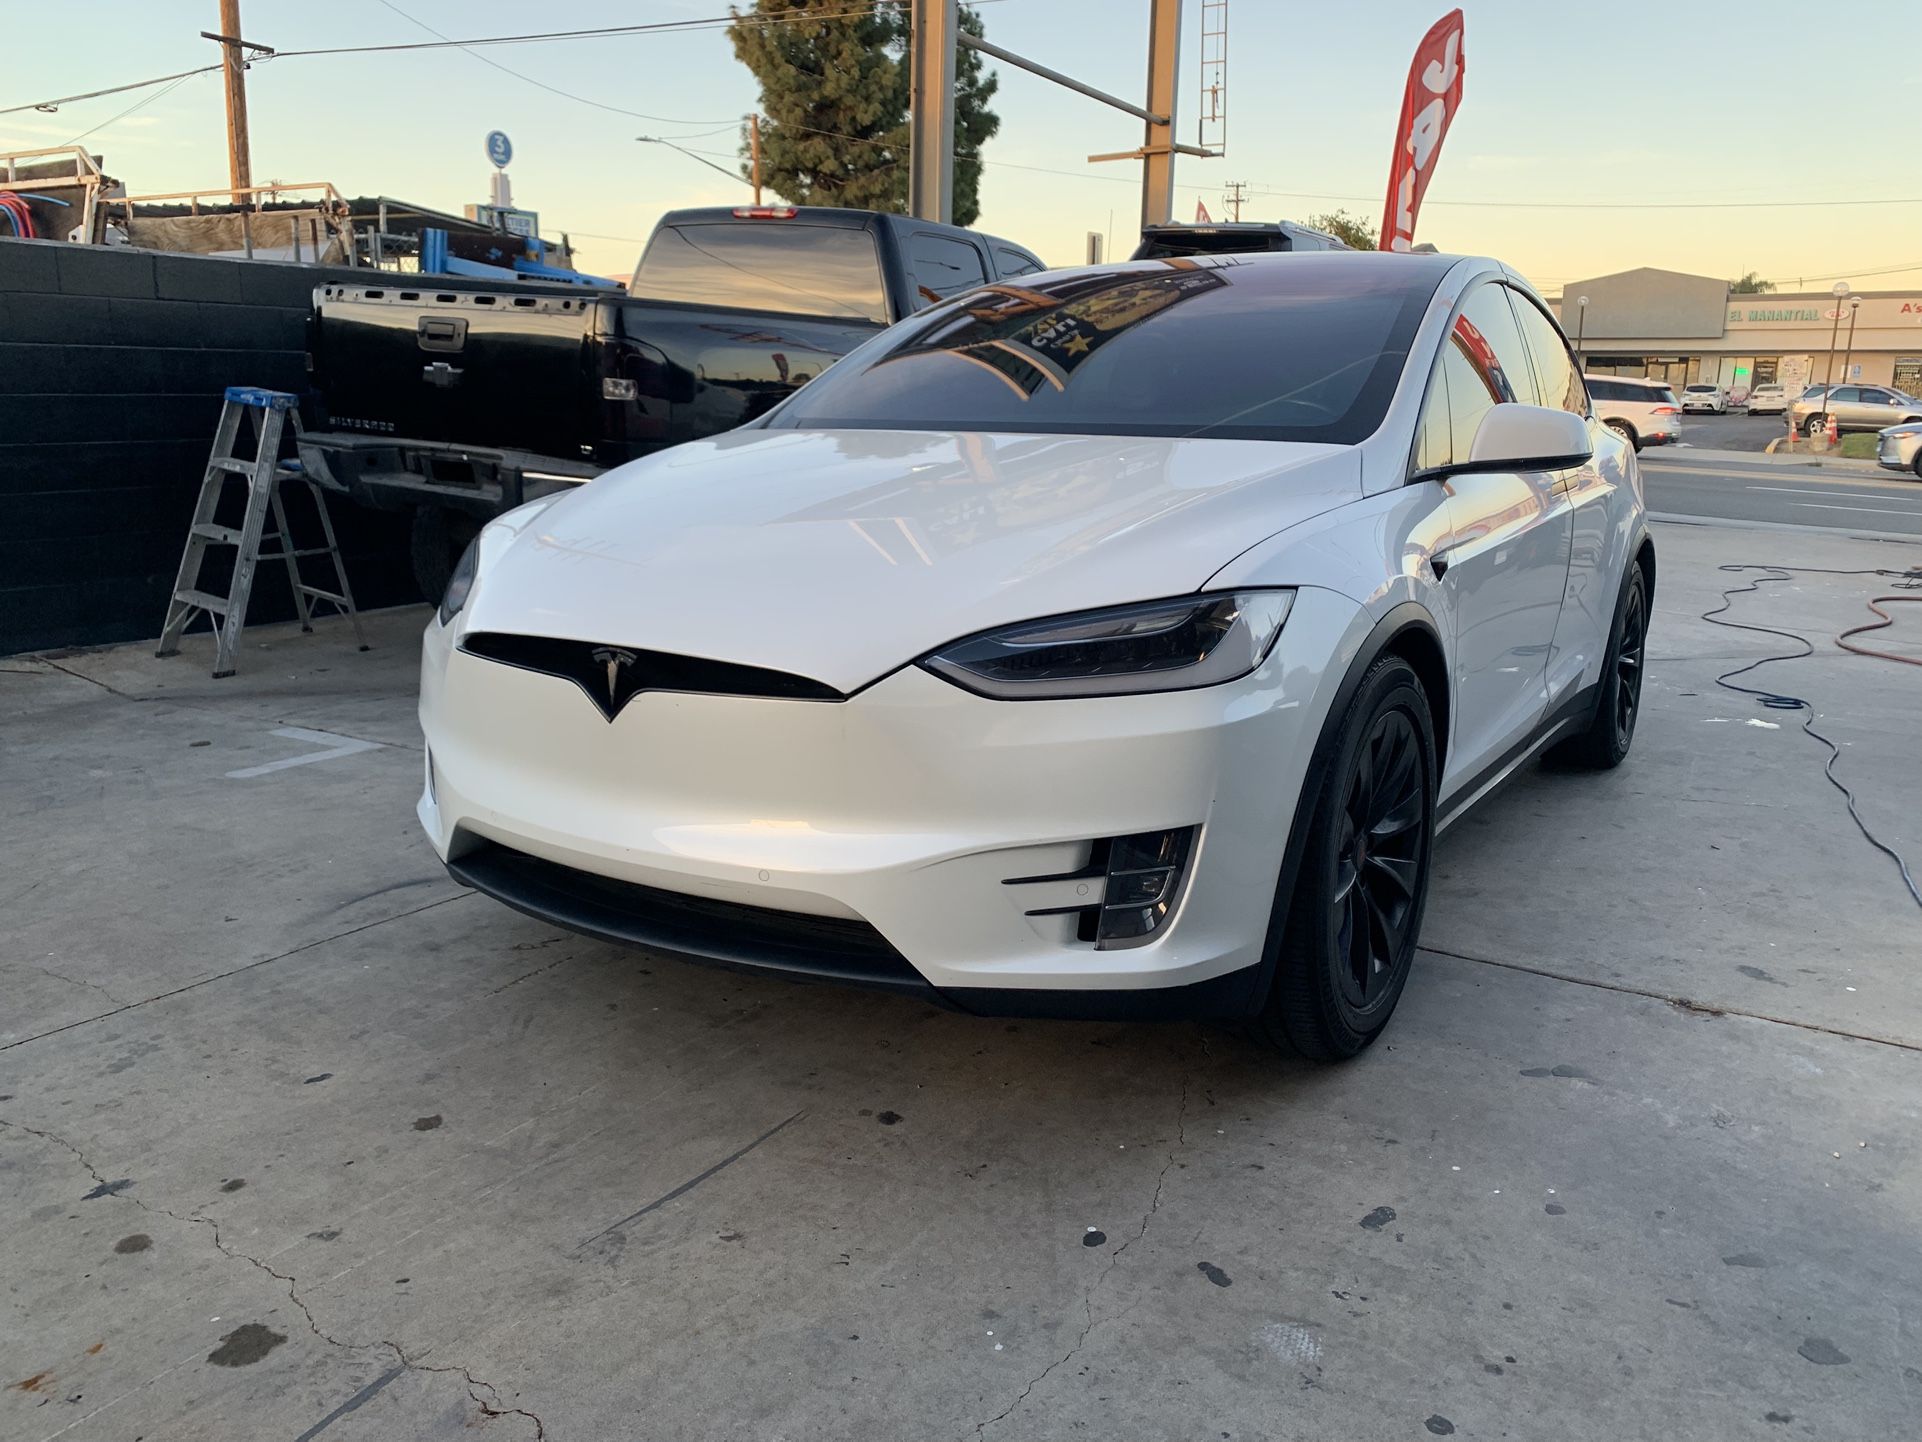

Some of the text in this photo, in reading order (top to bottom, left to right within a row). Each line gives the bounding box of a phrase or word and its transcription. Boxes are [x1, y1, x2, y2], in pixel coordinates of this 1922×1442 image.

[494, 134, 506, 153] 3
[1729, 309, 1743, 321] EL
[1748, 308, 1820, 321] MANANTIAL
